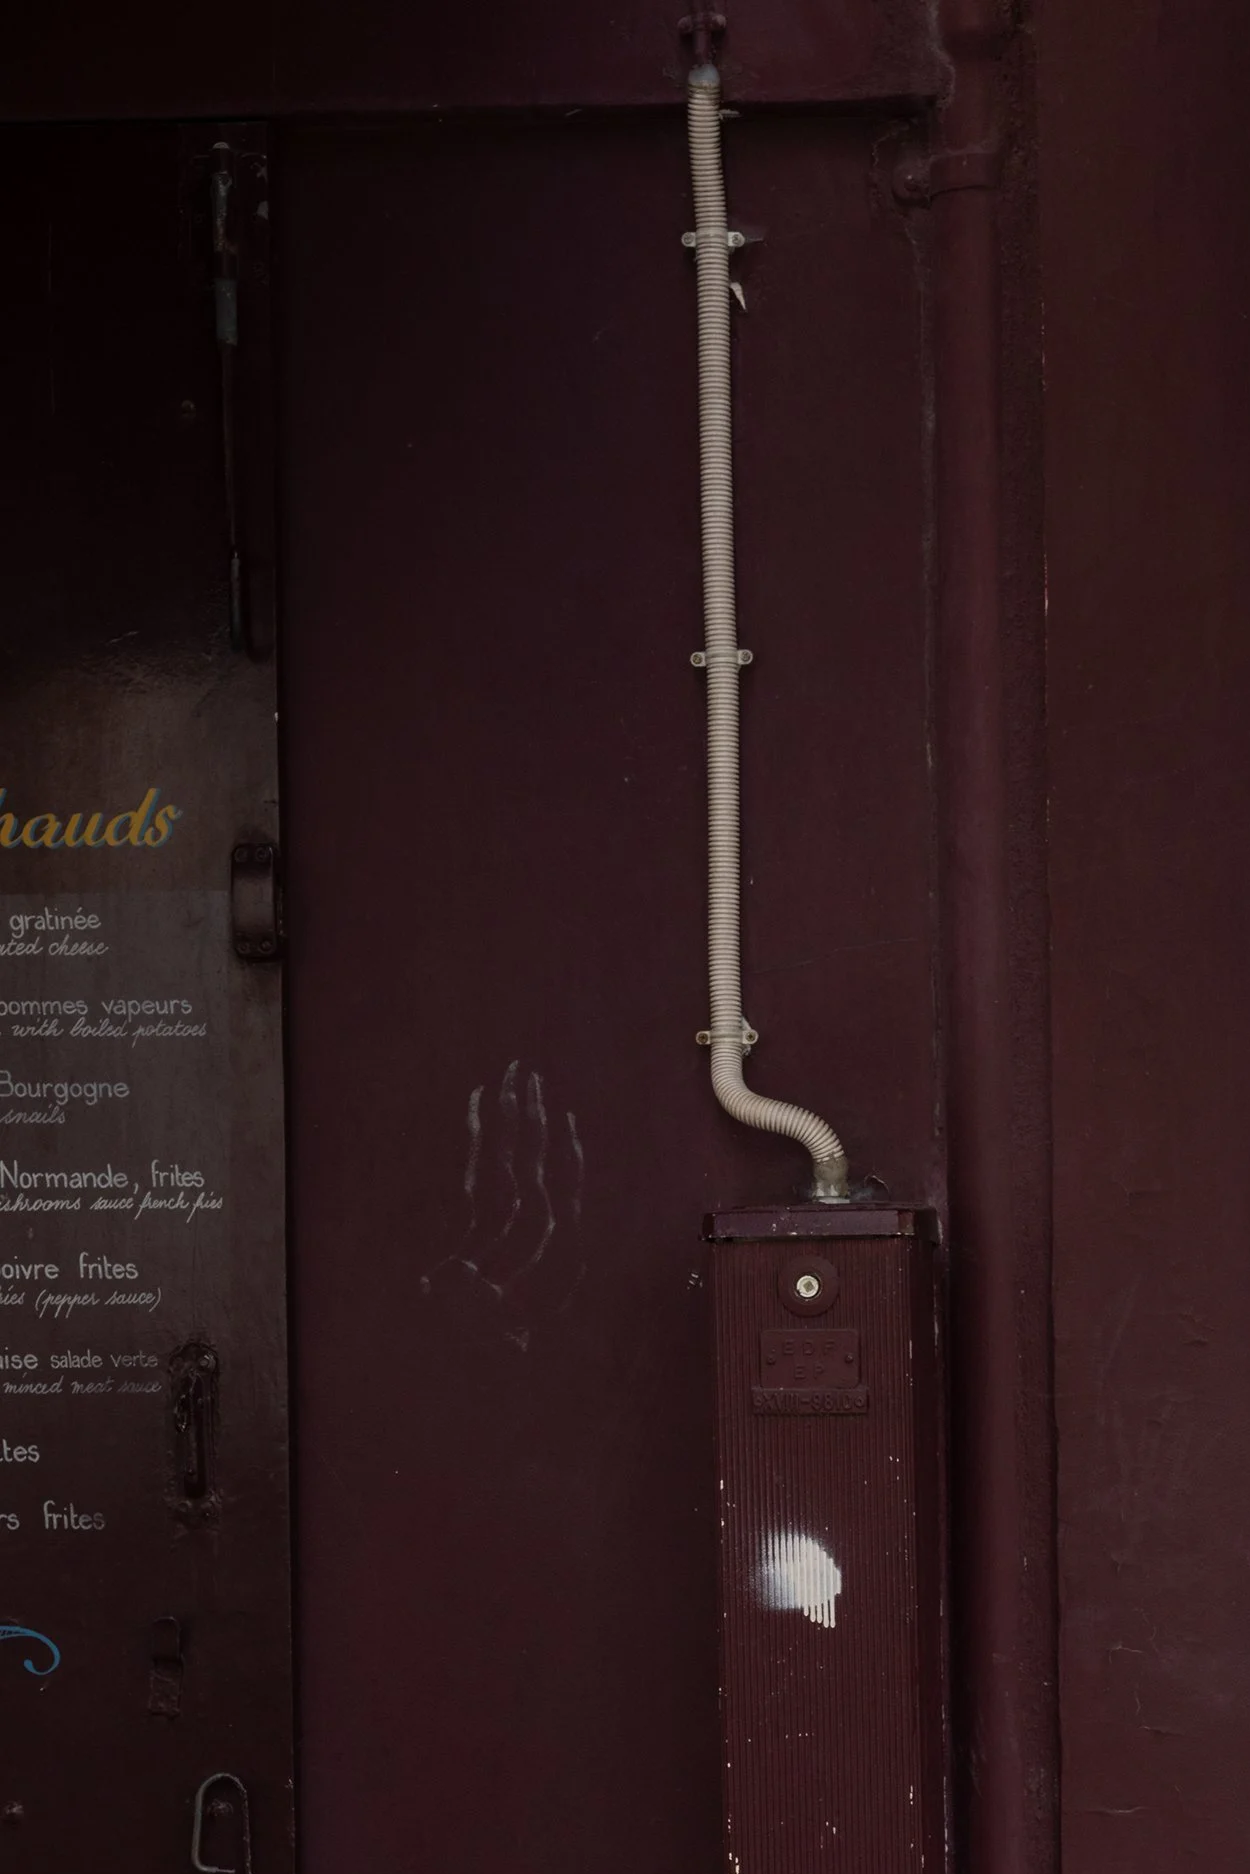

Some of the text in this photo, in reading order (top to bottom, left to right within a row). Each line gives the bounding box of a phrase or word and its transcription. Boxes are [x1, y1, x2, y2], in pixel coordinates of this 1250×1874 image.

[9, 907, 102, 938] gratinée
[49, 935, 110, 956] cheese
[101, 999, 193, 1022] vapeurs
[11, 1016, 207, 1048] with boiled potatoes
[0, 1070, 131, 1106] Bourgogne
[2, 1104, 66, 1124] snails
[151, 1159, 205, 1188] frites
[0, 1190, 223, 1224] shrooms sauce french fries
[79, 1251, 139, 1280] frites
[35, 1289, 101, 1318] (pepper
[104, 1287, 162, 1312] sauce)
[50, 1349, 104, 1369] salade
[110, 1350, 159, 1368] verte
[3, 1371, 63, 1394] minced
[71, 1377, 112, 1393] meat
[0, 1438, 40, 1463] tes
[43, 1500, 106, 1531] frites
